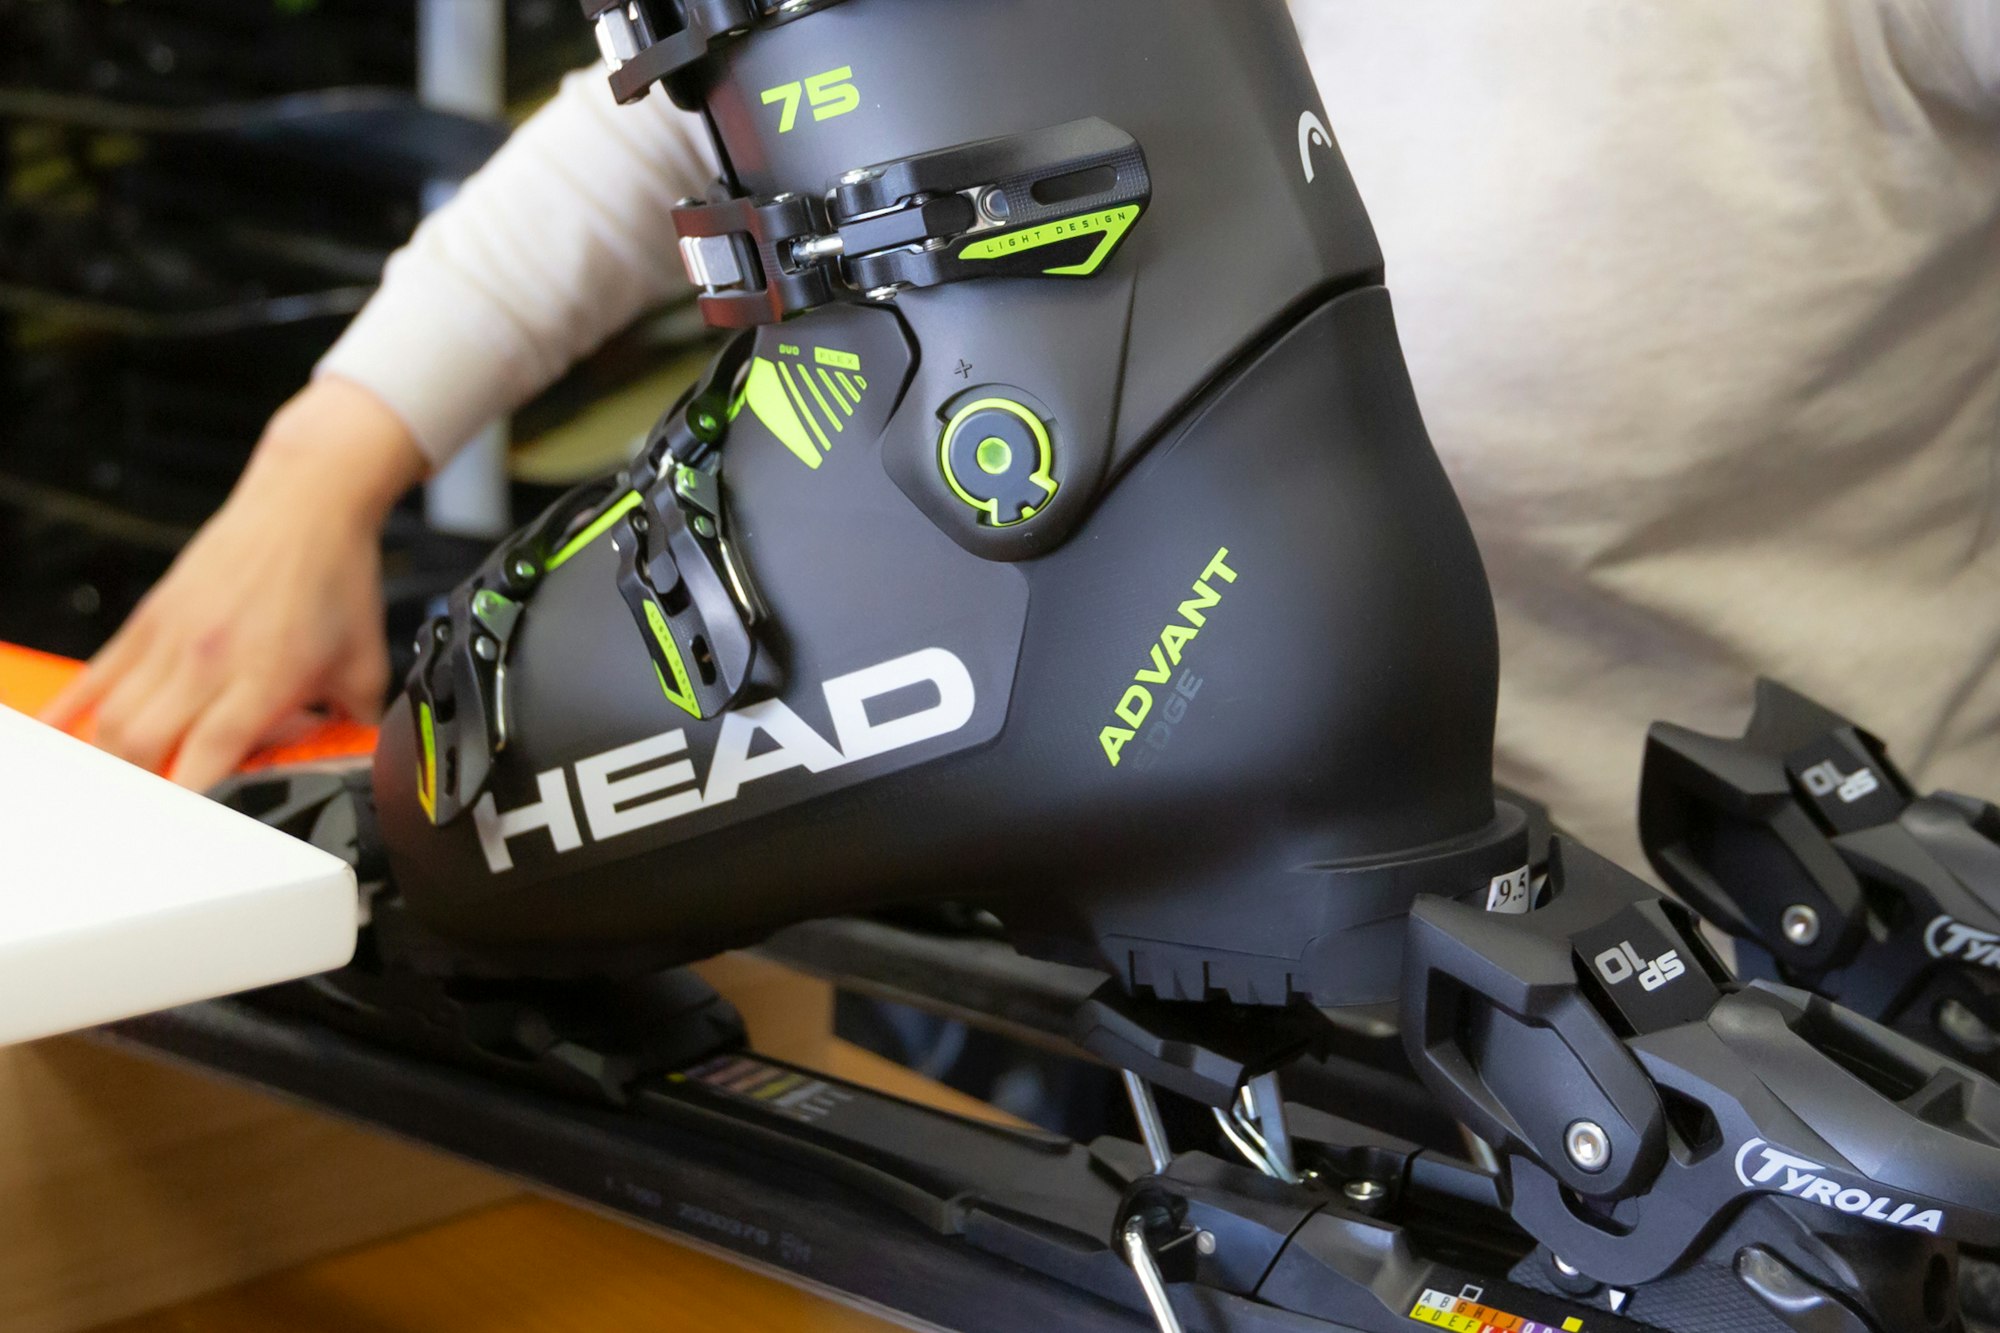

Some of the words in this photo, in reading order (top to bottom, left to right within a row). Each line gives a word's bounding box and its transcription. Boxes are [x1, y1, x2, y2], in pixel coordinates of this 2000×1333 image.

[760, 64, 860, 134] 75
[986, 231, 1041, 253] LIGHT
[1056, 212, 1127, 235] DESIGN
[779, 344, 800, 356] DUO
[820, 352, 854, 366] FLEX
[1098, 546, 1239, 768] ADVANT
[472, 646, 976, 874] HEAD
[1594, 940, 1647, 985] 10
[1638, 949, 1686, 992] SP
[1752, 1147, 1943, 1233] TYROLIA
[1415, 1305, 1426, 1317] C
[1431, 1310, 1442, 1322] D
[1447, 1316, 1459, 1327] E
[1464, 1320, 1475, 1332] F
[1422, 1292, 1433, 1304] A
[1439, 1296, 1450, 1308] B
[1457, 1303, 1467, 1314] G
[1472, 1307, 1484, 1319] H
